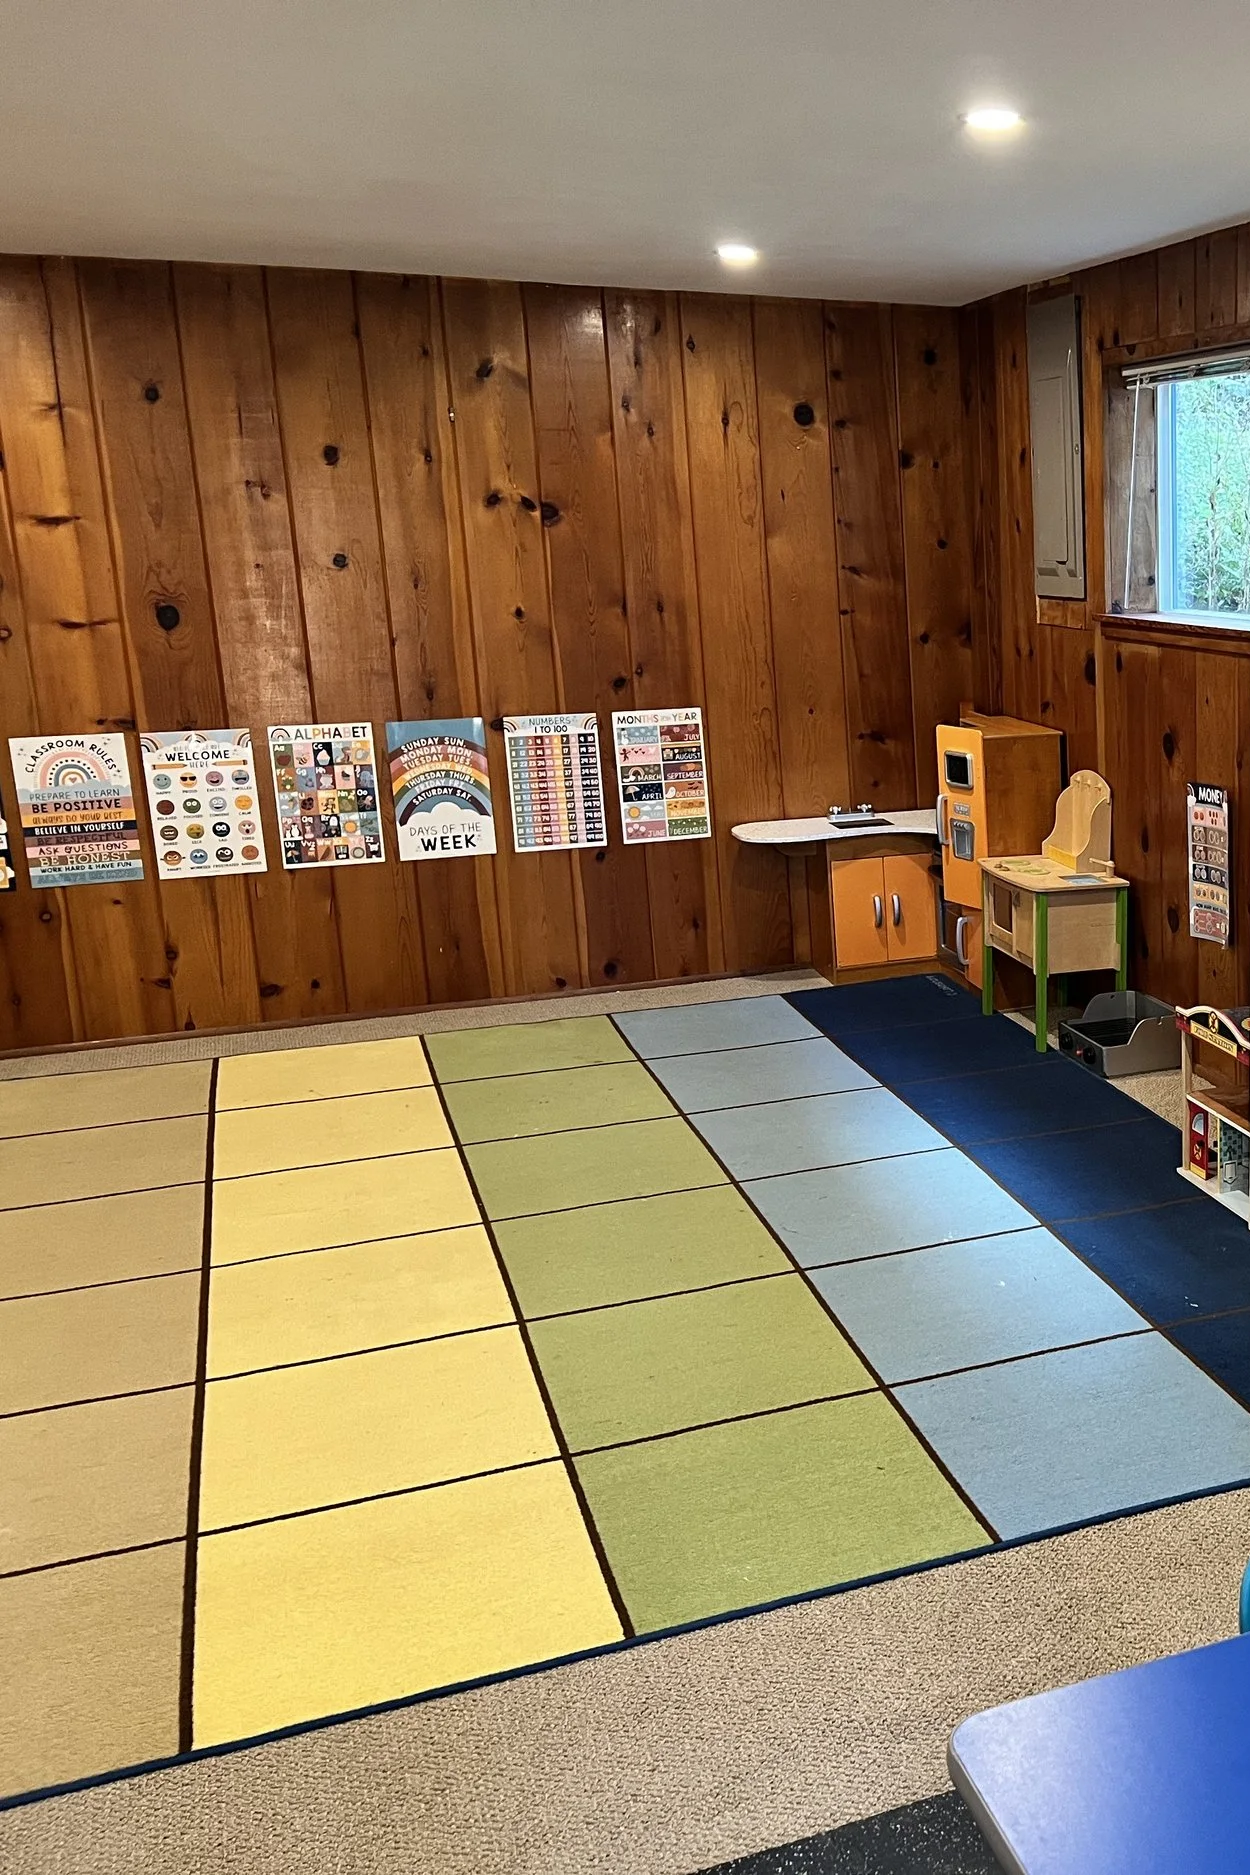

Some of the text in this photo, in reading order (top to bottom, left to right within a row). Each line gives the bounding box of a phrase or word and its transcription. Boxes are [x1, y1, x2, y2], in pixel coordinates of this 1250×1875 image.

[528, 716, 572, 726] NUMBERS
[672, 712, 697, 722] YEAR
[294, 726, 367, 740] ALPHABET
[534, 725, 568, 734] 1 TO 100
[683, 733, 700, 741] JULY
[400, 736, 467, 753] SUNDAY SUN.
[25, 739, 117, 773] CLASSROOM RULES
[165, 749, 231, 762] WELCOME
[399, 745, 474, 764] MONDAY MON.
[675, 752, 701, 760] AUGUST
[402, 753, 473, 771] TUESDAY TUES.
[405, 770, 476, 789] THURSDAY THURS.
[666, 771, 703, 780] SEPTEMBER
[414, 779, 446, 793] FRIDAY
[29, 788, 120, 801] PREPARE TO LEARN
[412, 787, 472, 805] SATURDAY SAT.
[641, 792, 662, 800] APRIL
[675, 789, 705, 798] OCTOBER
[1198, 786, 1222, 804] MONEY
[31, 798, 122, 814] BE POSITIVE
[66, 814, 77, 823] DO
[80, 812, 101, 822] YOUR
[34, 822, 125, 836] BELIEVE IN YOURSELF
[409, 821, 482, 837] DAYS OF THE
[648, 829, 665, 837] JUNE
[673, 826, 707, 835] DECEMBER
[37, 831, 127, 846] BE RESPECTFUL
[420, 834, 477, 852] WEEK
[38, 841, 128, 856] ASK QUESTIONS
[39, 851, 131, 867] BE HONEST
